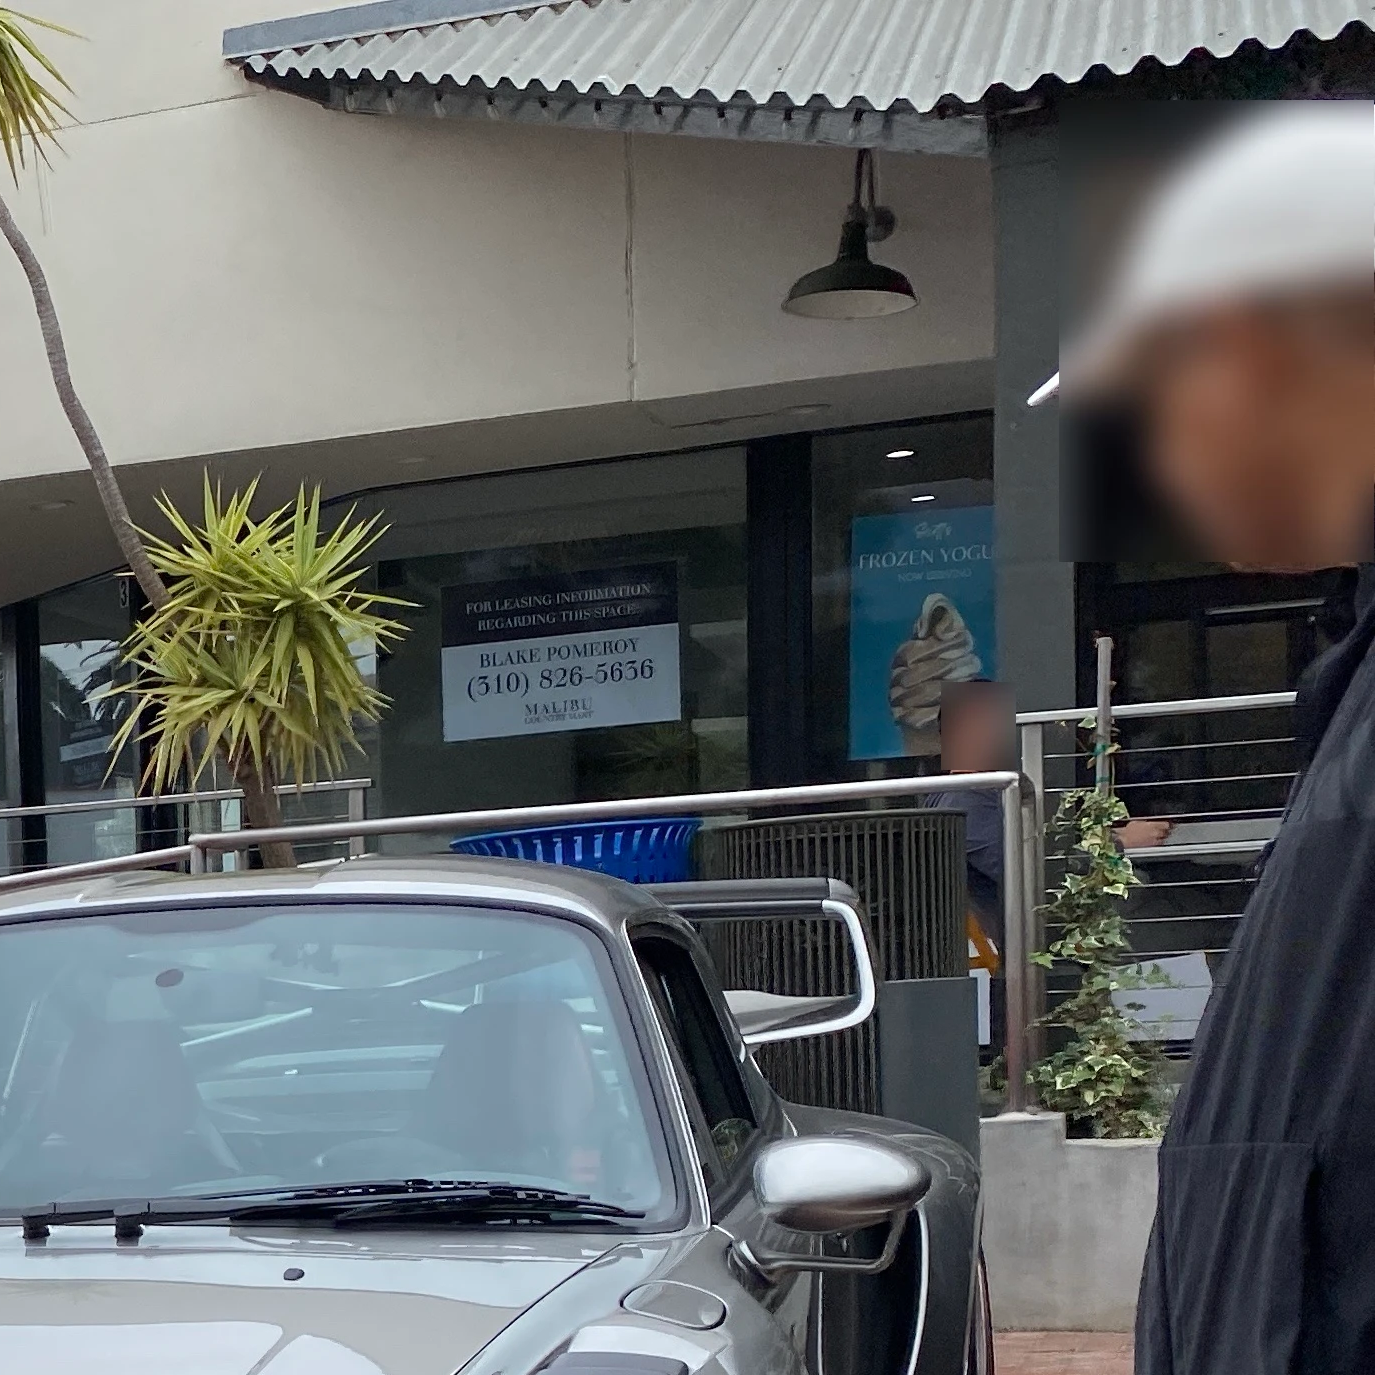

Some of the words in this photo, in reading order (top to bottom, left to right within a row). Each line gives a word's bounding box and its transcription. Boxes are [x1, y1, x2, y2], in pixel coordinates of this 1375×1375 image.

[859, 550, 934, 569] FROZEN
[466, 602, 492, 615] FOR
[495, 594, 552, 611] LEASING
[556, 583, 651, 604] INFORMATION
[478, 612, 556, 631] REGARDING
[561, 609, 591, 623] THIS
[480, 650, 541, 669] BLAKE
[547, 638, 640, 662] POMEROY
[467, 672, 529, 703] (310)
[539, 659, 654, 690] 826-5636
[525, 698, 592, 715] MALIBU
